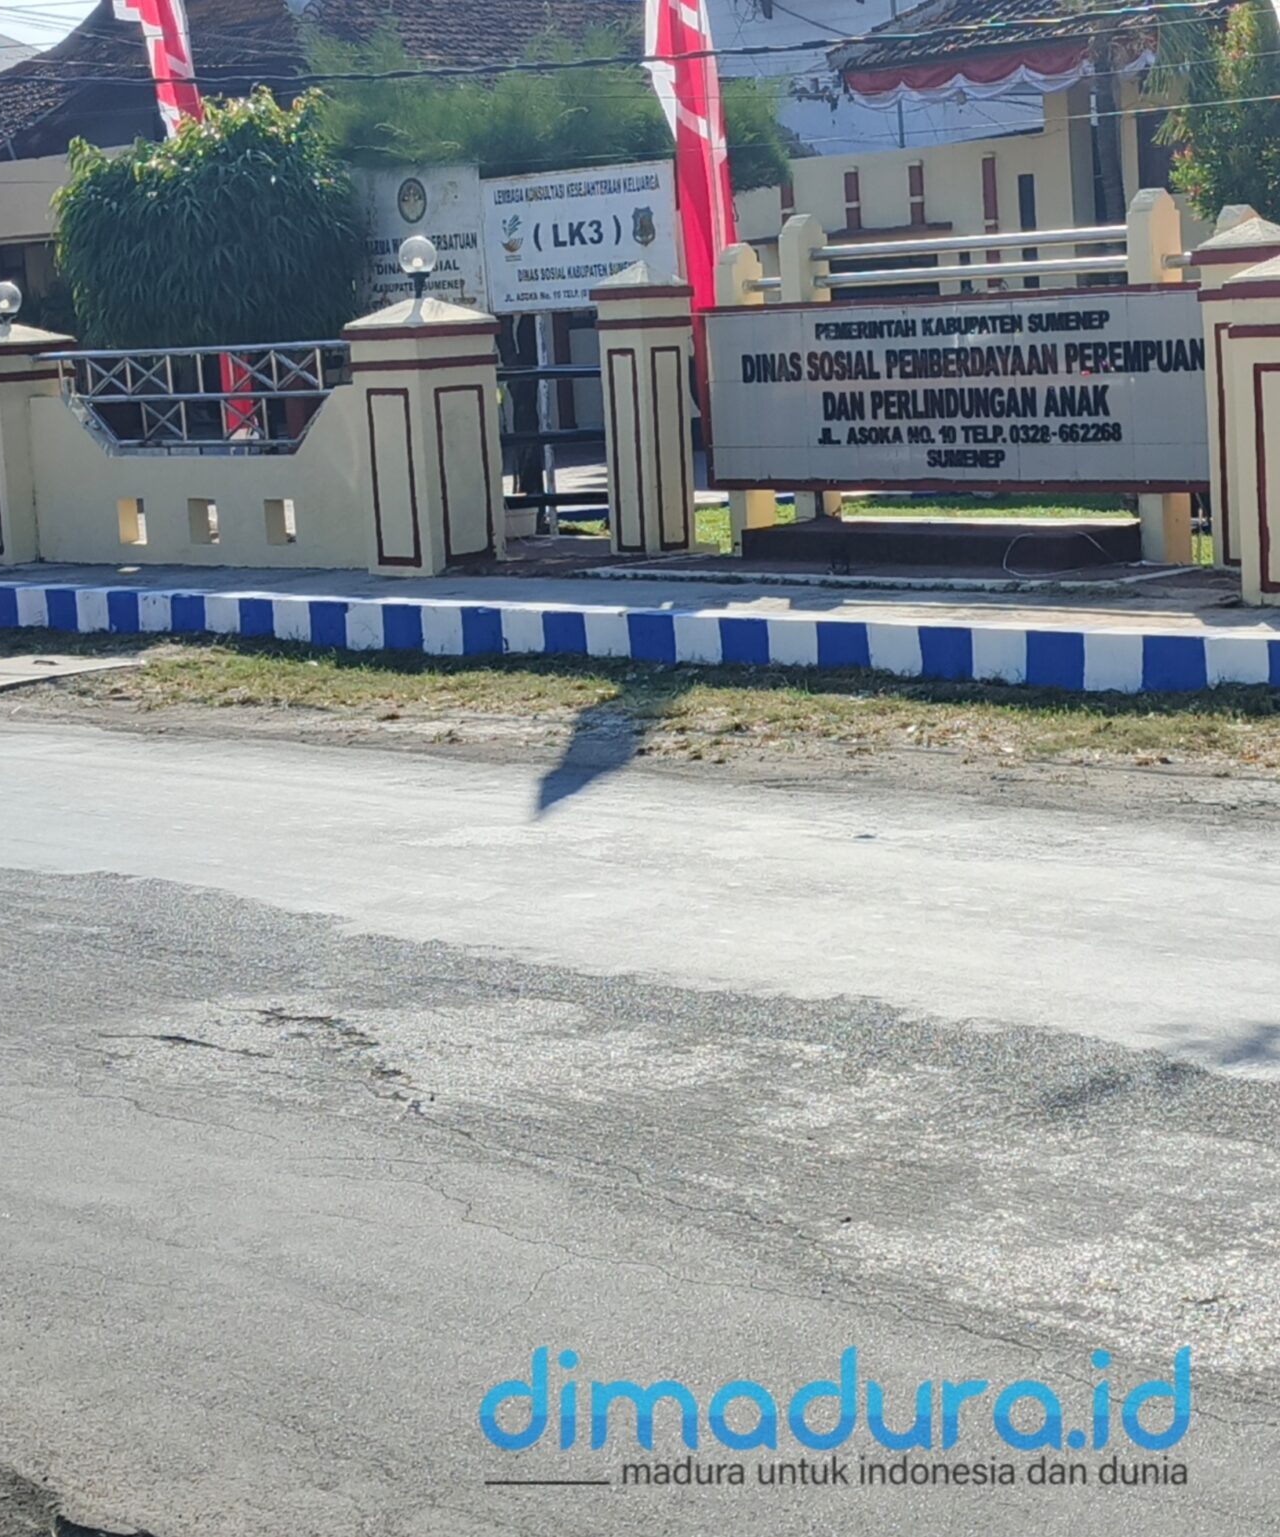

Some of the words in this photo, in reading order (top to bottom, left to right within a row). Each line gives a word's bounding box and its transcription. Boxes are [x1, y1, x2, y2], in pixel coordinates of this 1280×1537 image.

[815, 319, 917, 341] PEMERINTAH
[921, 314, 1023, 336] KABUPATEN
[1028, 310, 1110, 333] SUMENEP
[741, 351, 802, 383] DINAS
[807, 349, 881, 382] SOSIAL
[885, 343, 1058, 379] PEMBERDAYAAN
[1064, 338, 1205, 375] PEREMPUAN
[822, 390, 865, 421] DAN
[871, 386, 1037, 420] PERLINDUNGAN
[1044, 384, 1110, 418] ANAK
[846, 425, 904, 445] ASOKA
[907, 425, 936, 444] NO.
[938, 425, 957, 444] 10
[961, 424, 1007, 444] TELP.
[1009, 422, 1122, 444] 0328-662268
[926, 449, 1006, 469] SUMENEP
